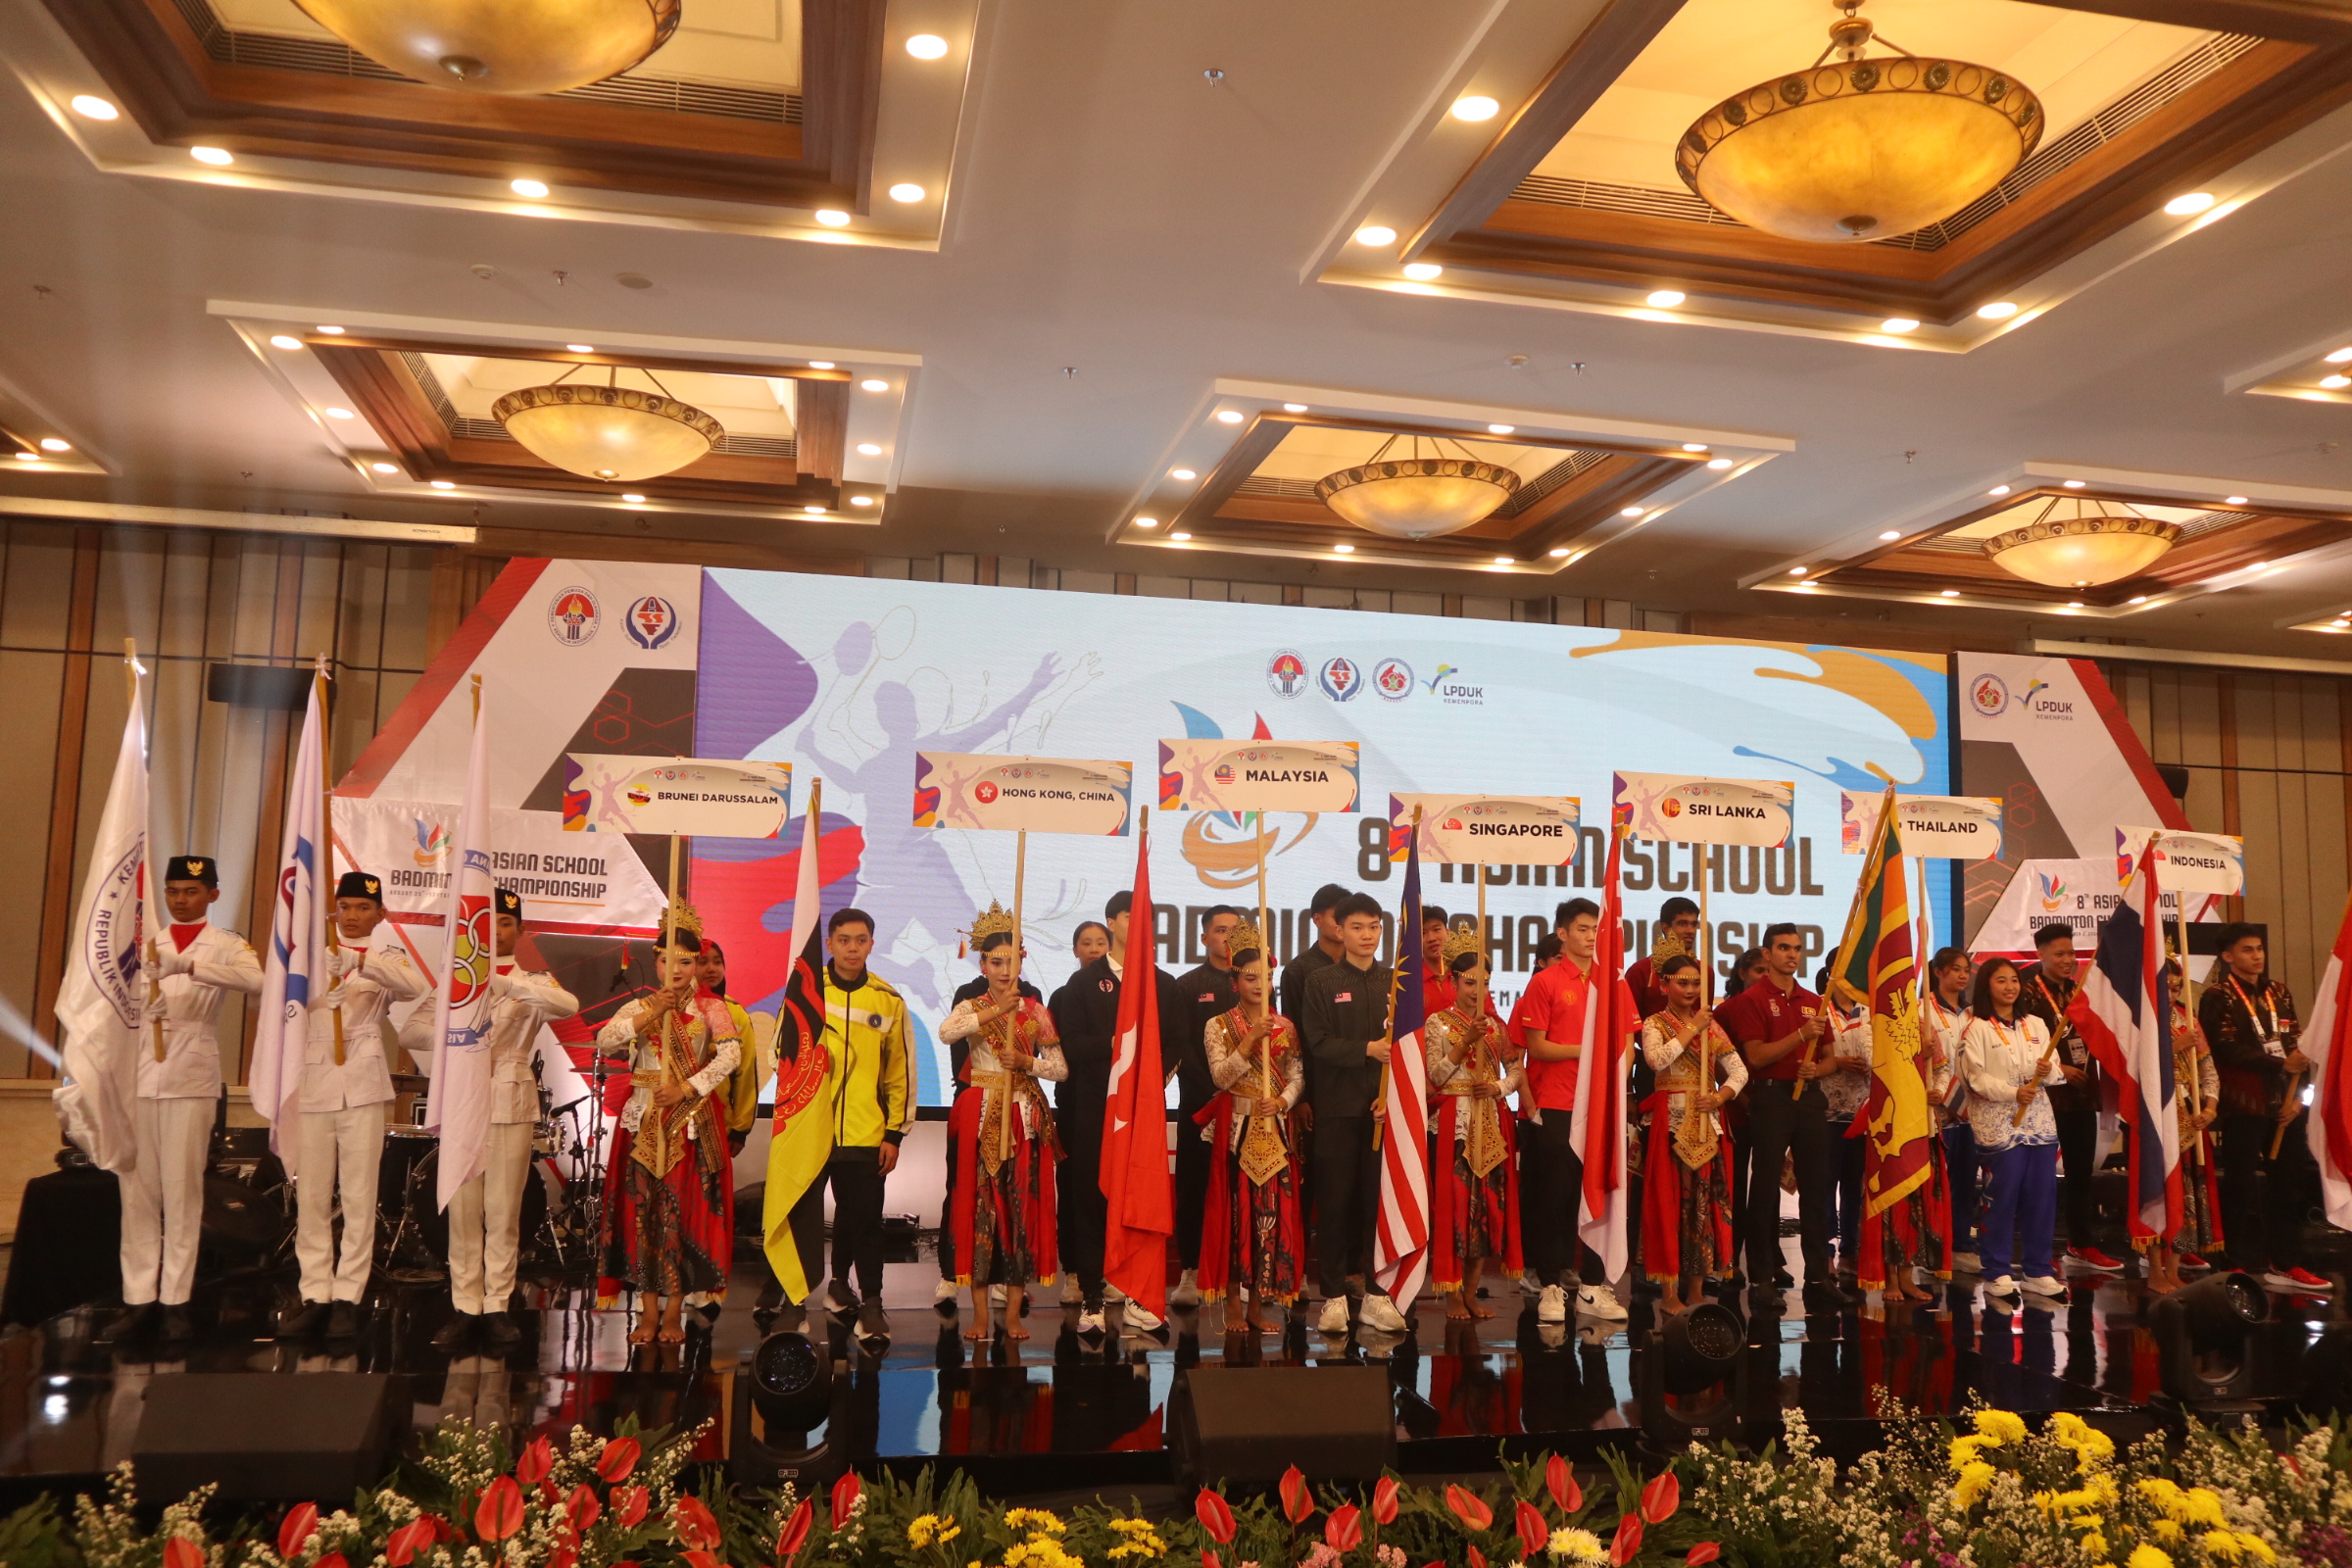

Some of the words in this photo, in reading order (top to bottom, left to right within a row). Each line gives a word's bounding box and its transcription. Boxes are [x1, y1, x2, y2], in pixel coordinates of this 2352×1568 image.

[1443, 685, 1484, 698] LPDUK
[2035, 701, 2073, 712] LPDUK
[1246, 769, 1329, 783] MALAYSIA
[658, 791, 699, 802] BRUNEI
[702, 793, 778, 805] DARUSSALAM
[1002, 788, 1037, 799] HONG
[1039, 790, 1076, 802] KONG,
[1078, 791, 1115, 802] CHINA
[1689, 804, 1712, 816] SRI
[1716, 806, 1766, 819] LANKA
[1469, 823, 1563, 838] SINGAPORE
[1907, 820, 1978, 833] THAILAND
[543, 854, 609, 877] SCHOOL
[2171, 855, 2227, 870] INDONESIA
[2093, 894, 2122, 909] ASIA
[94, 908, 118, 985] REPUBLIK
